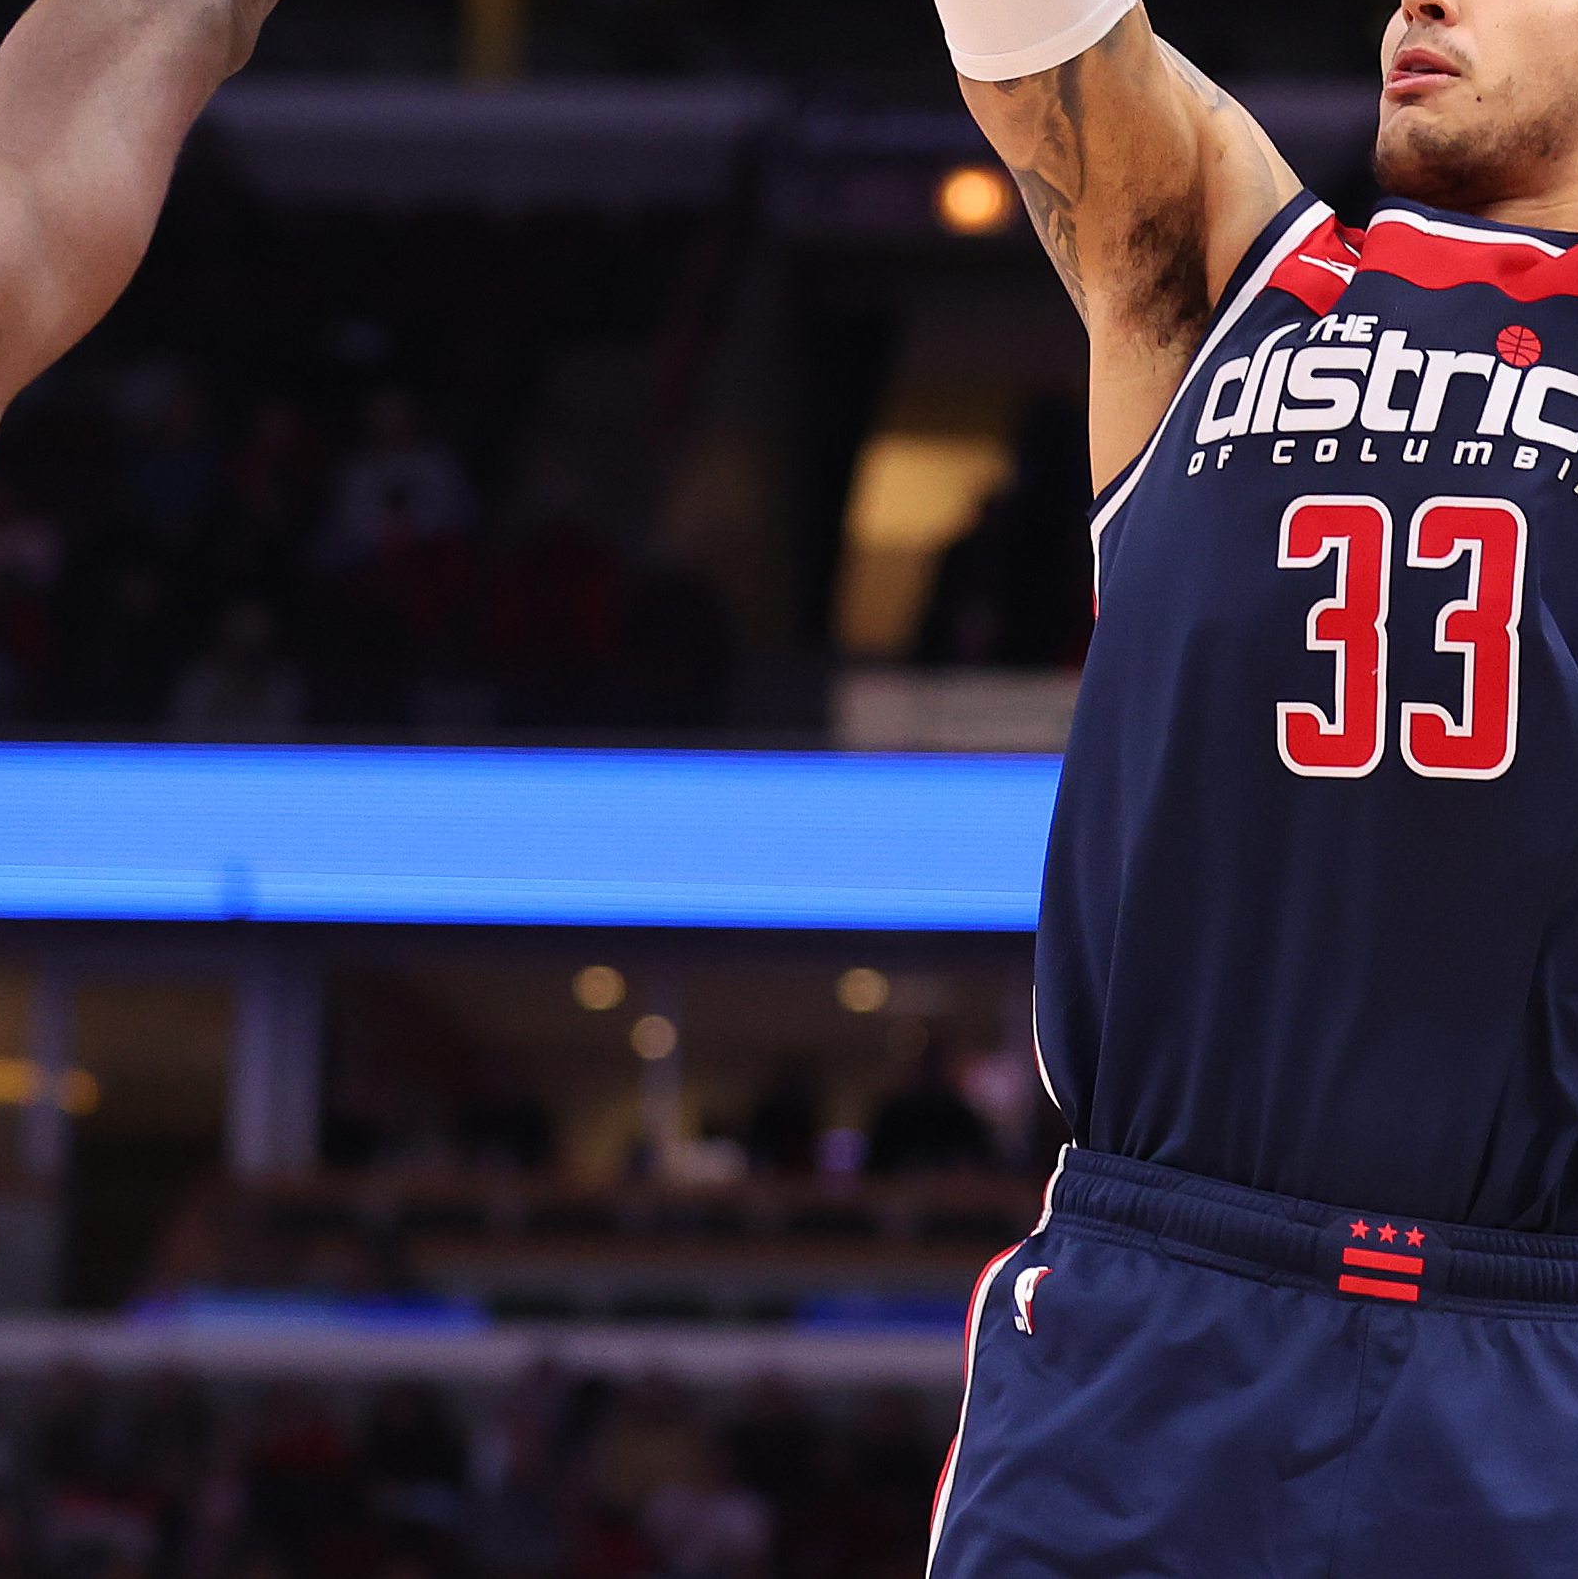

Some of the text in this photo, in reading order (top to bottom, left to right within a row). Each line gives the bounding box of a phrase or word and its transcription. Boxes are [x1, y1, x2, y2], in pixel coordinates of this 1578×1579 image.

[1306, 314, 1379, 342] THE
[1187, 443, 1233, 477] OF
[1276, 494, 1528, 781] 33
